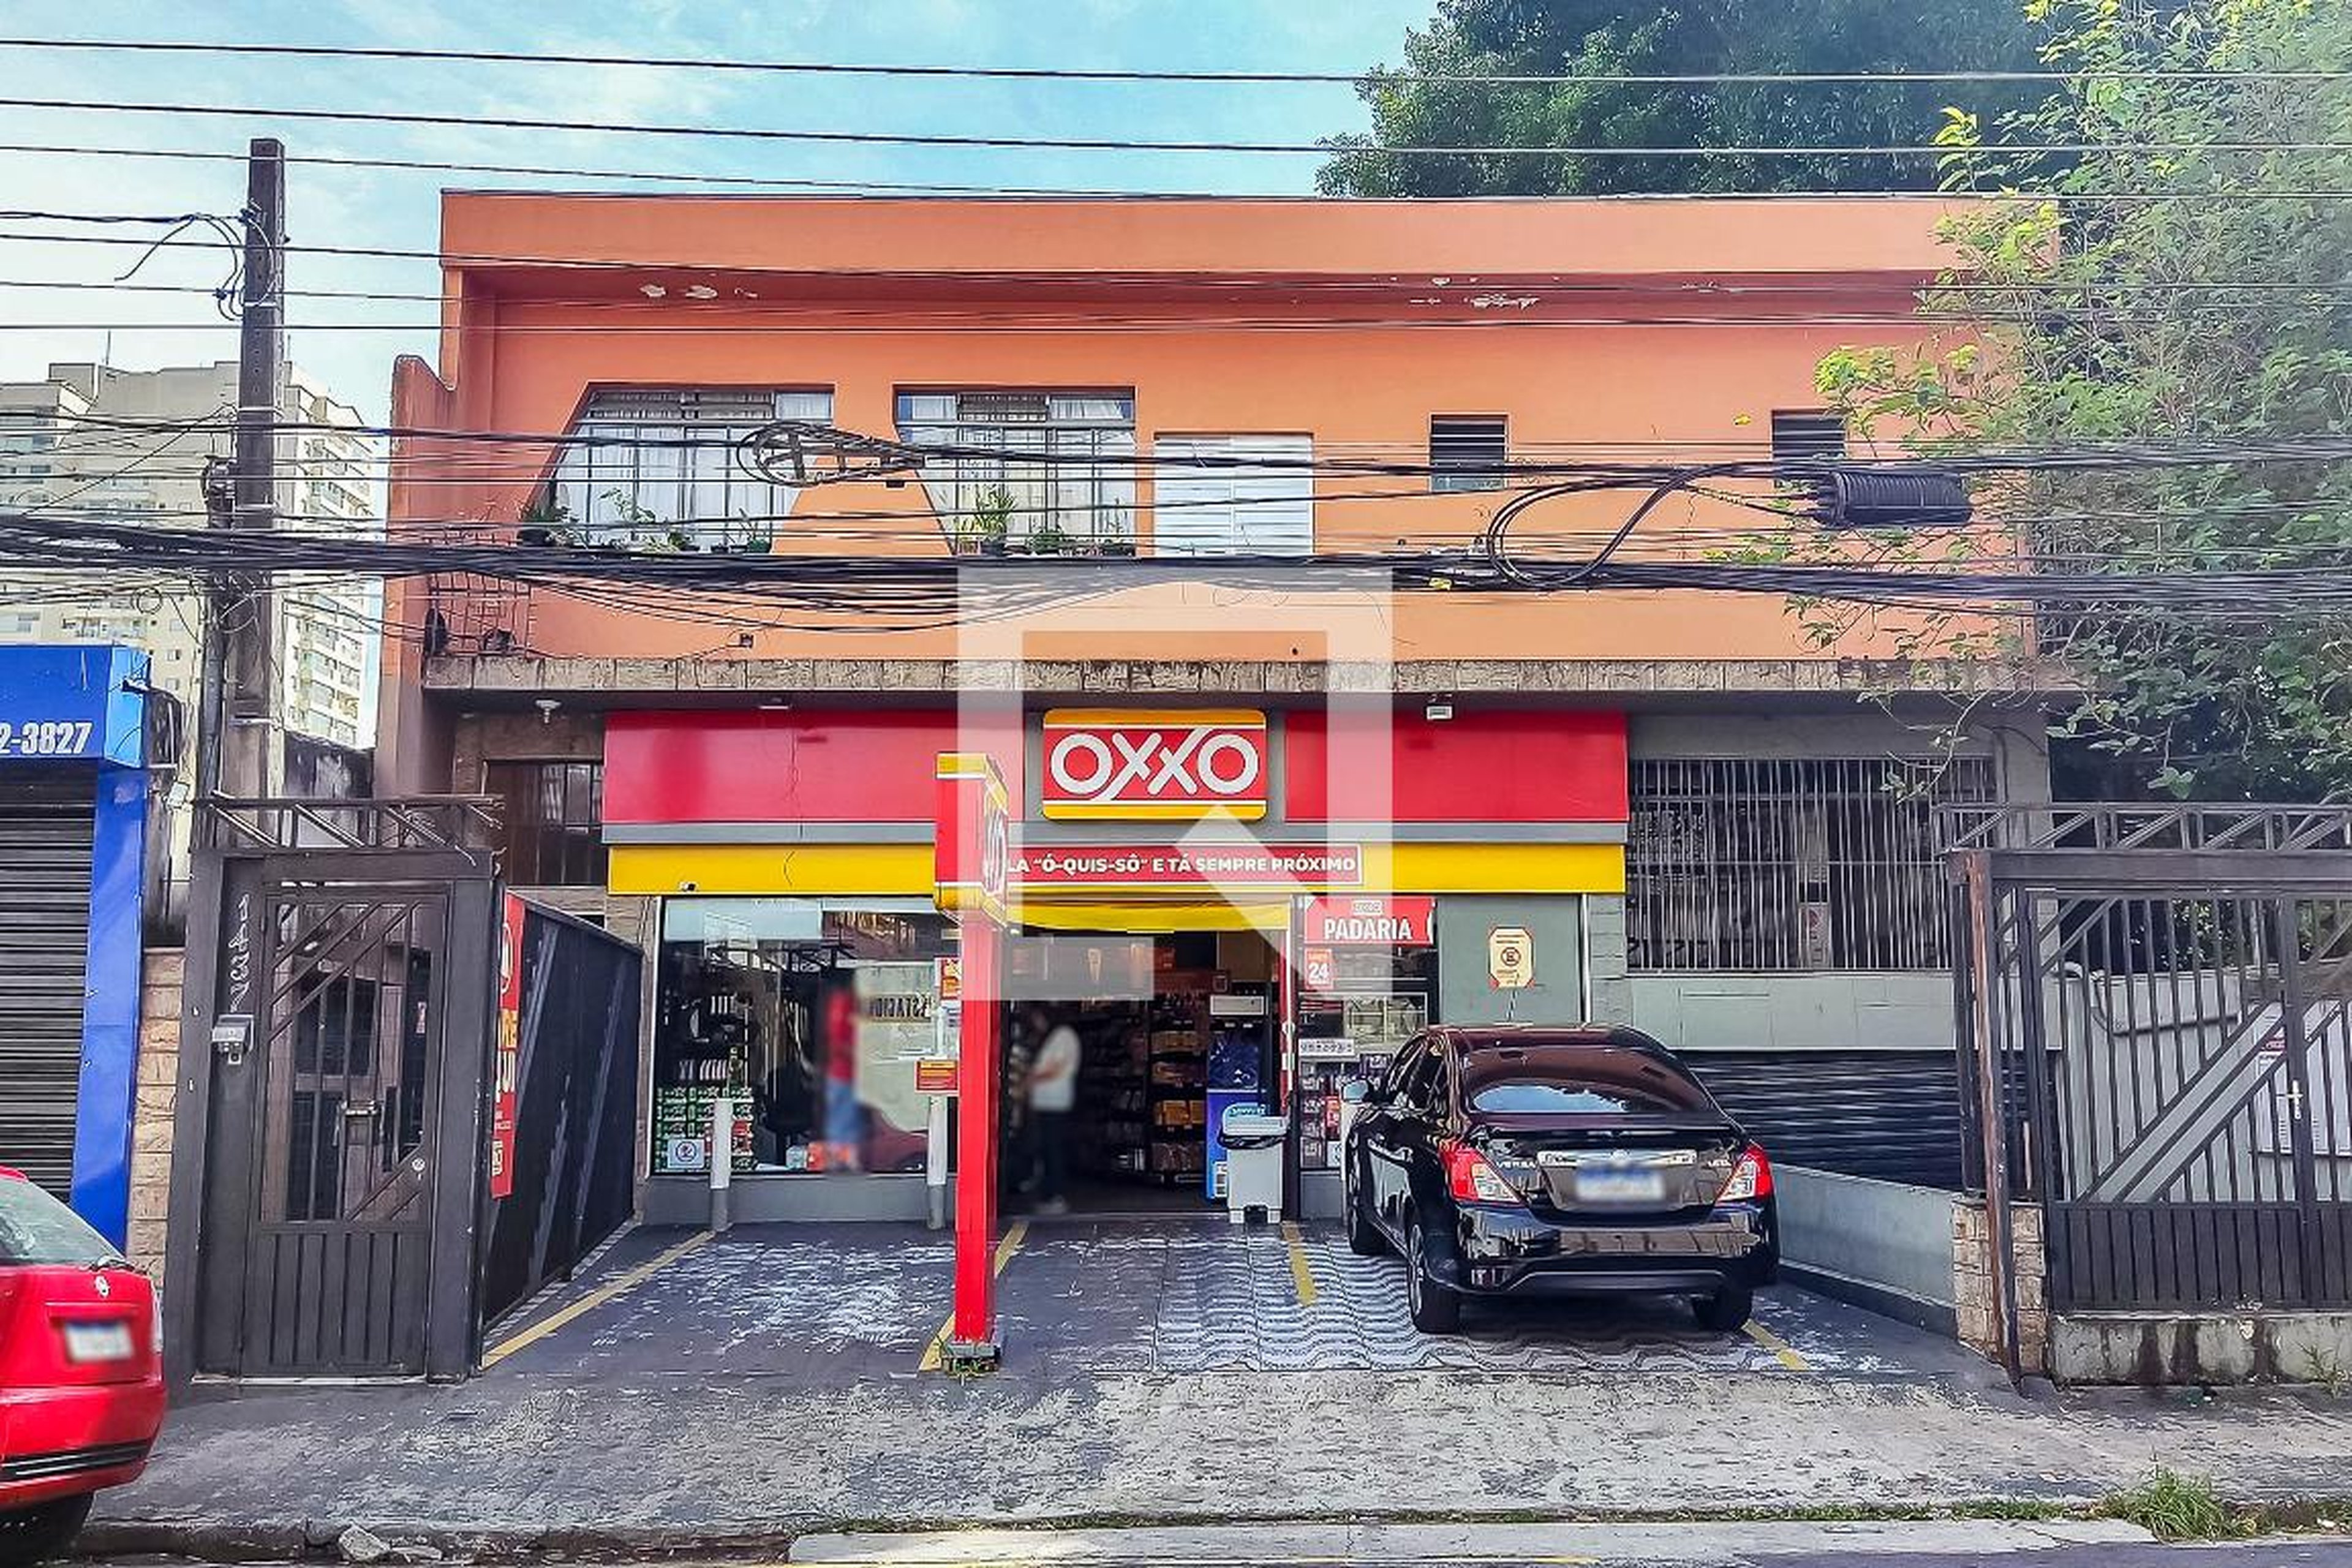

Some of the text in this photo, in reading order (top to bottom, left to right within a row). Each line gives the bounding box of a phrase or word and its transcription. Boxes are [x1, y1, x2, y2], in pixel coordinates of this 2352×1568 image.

[1050, 727, 1260, 801] OXXO
[1153, 858, 1163, 872] E
[1167, 854, 1191, 872] TÁ
[1195, 858, 1268, 872] SEMPRE
[1272, 854, 1355, 872] PRÓXIMO
[1324, 918, 1412, 940] PADARIA
[1308, 962, 1329, 979] 24
